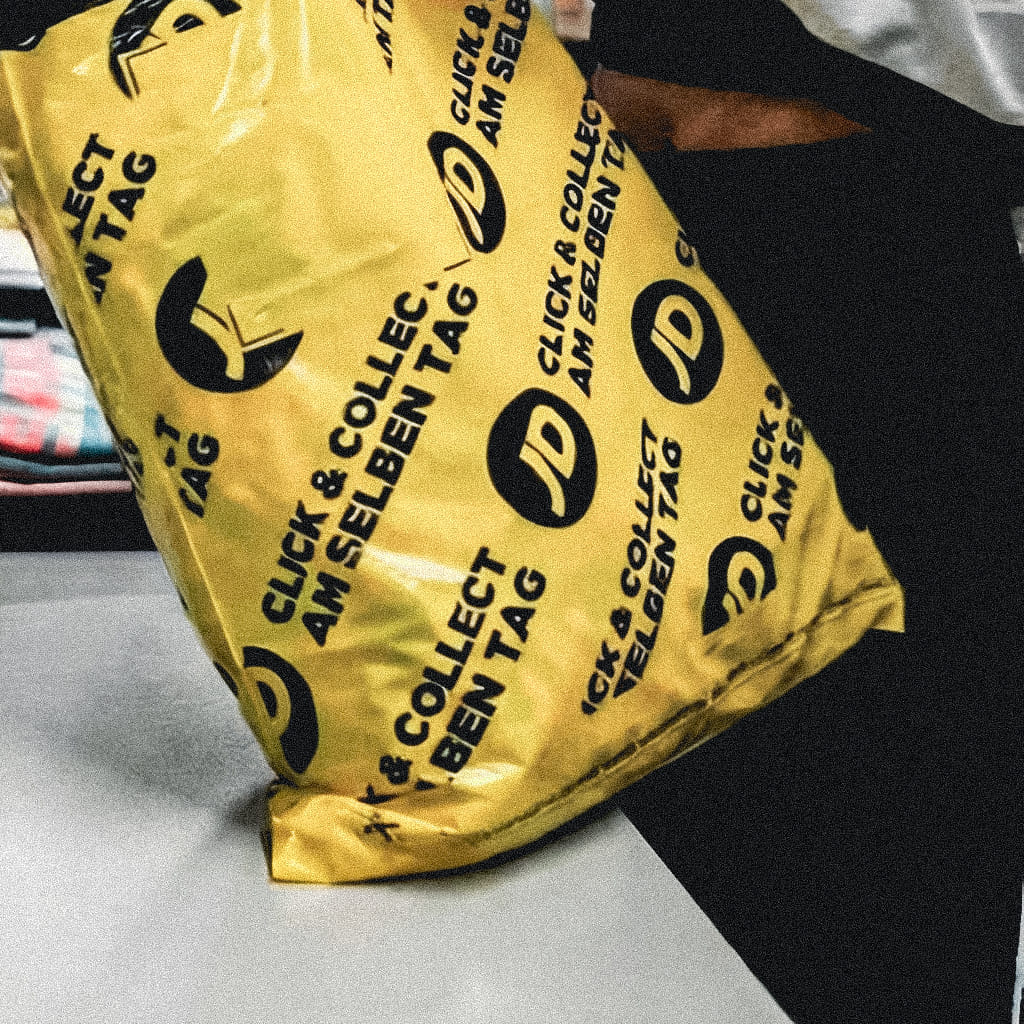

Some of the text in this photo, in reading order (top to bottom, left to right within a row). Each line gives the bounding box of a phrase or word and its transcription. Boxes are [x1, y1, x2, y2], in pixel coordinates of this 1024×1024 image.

[450, 27, 485, 126] CLICK
[476, 84, 507, 149] AM
[92, 150, 157, 242] TAG
[537, 265, 574, 376] CLICK
[560, 94, 602, 232] COLLEC
[568, 328, 594, 399] AM
[261, 281, 439, 624] CLICK & COLLEC
[301, 282, 479, 648] AM SELBEN TAG
[740, 409, 779, 522] CLICK
[767, 473, 798, 543] AM
[393, 546, 507, 747] COLLECT
[484, 565, 548, 662] TAG
